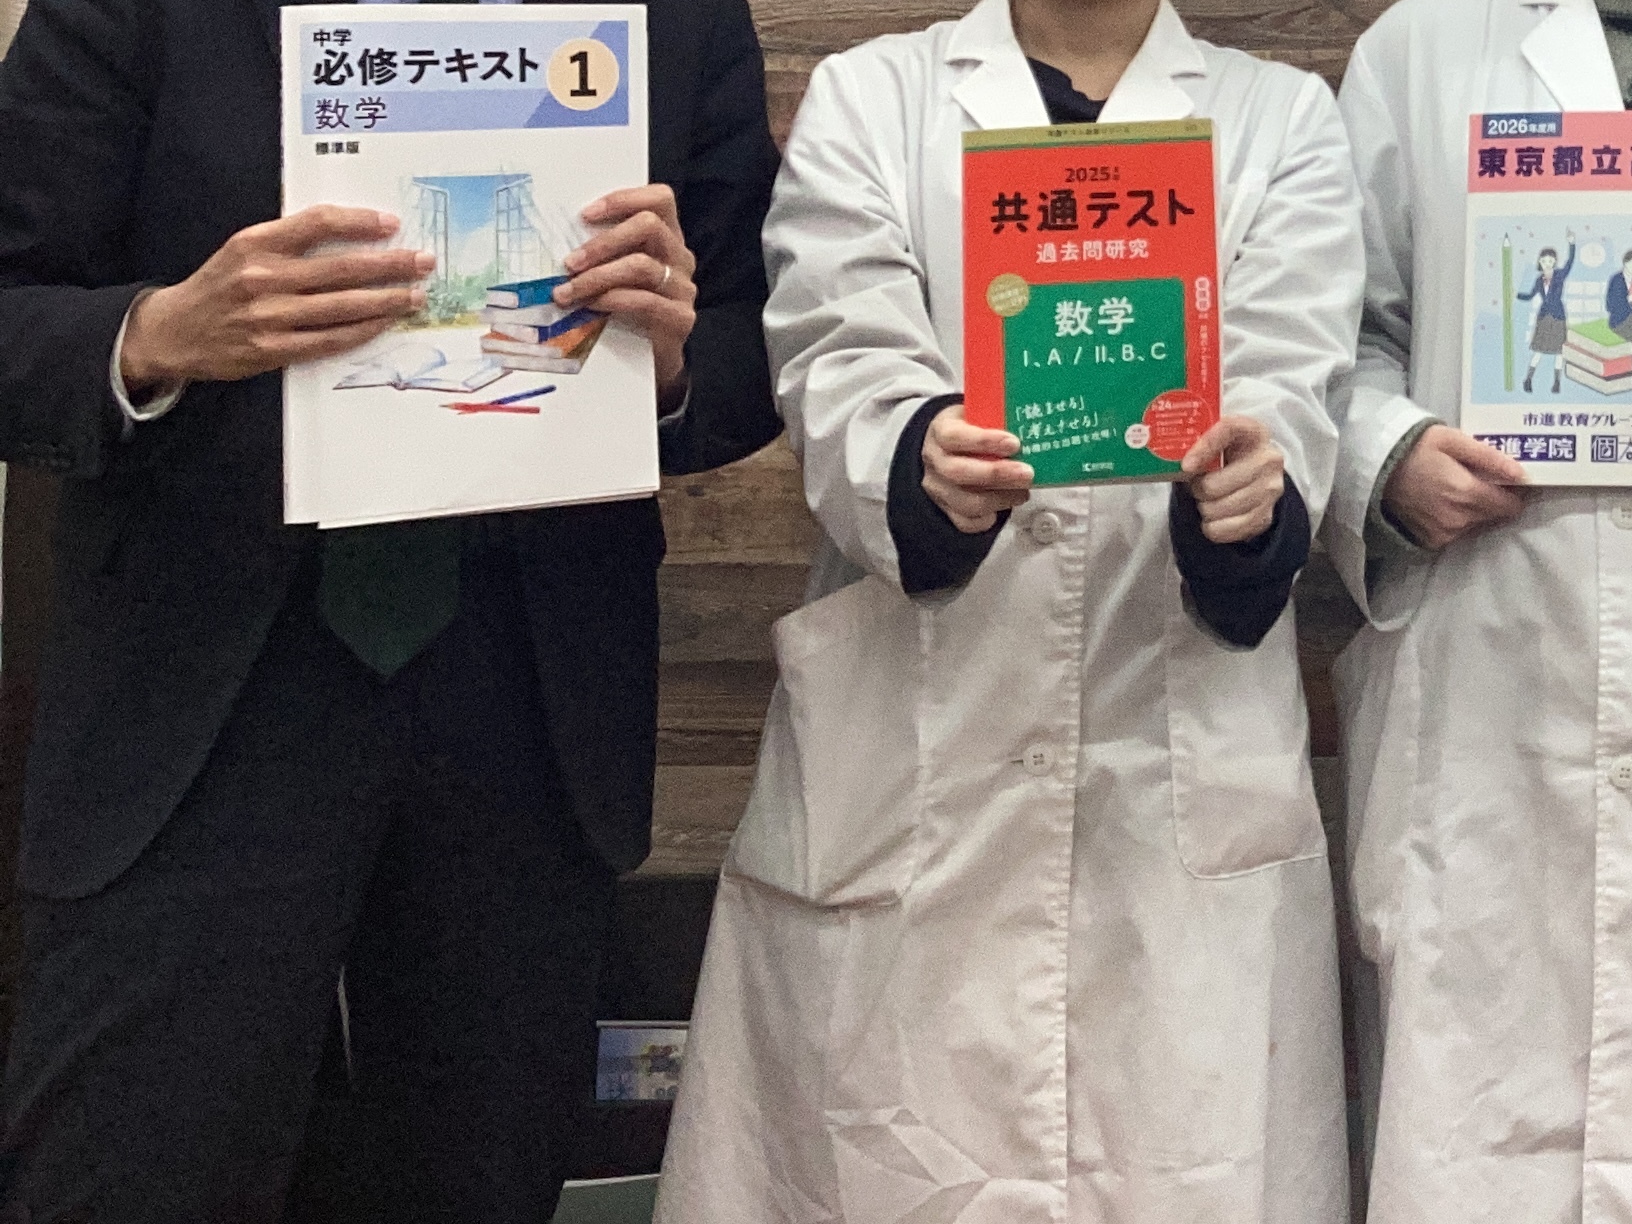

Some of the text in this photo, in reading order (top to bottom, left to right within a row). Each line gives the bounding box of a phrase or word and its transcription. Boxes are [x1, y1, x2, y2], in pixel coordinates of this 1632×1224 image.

[312, 28, 352, 47] 中学
[313, 46, 598, 98] 必修テキスト 1
[315, 96, 388, 130] 数学
[315, 141, 360, 155] 標準版
[991, 189, 1194, 234] 共通テスト
[1036, 238, 1149, 263] 過去問研究
[1054, 296, 1135, 338] 数学
